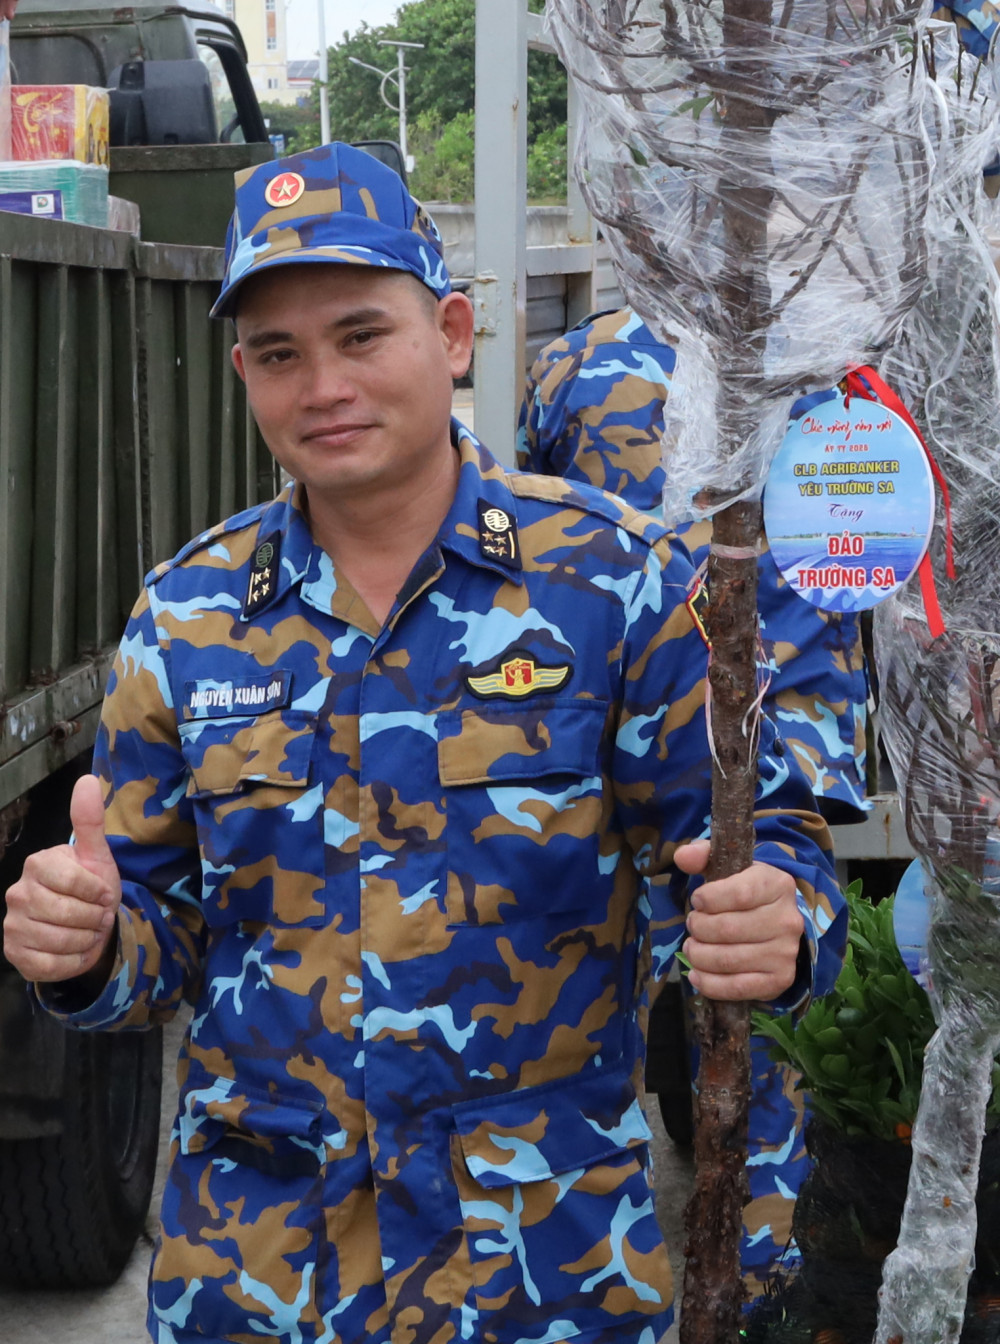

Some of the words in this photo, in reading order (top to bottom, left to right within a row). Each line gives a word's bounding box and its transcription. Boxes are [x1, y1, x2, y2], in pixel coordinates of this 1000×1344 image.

[794, 463, 817, 476] CLB
[820, 460, 900, 476] AGRIBANKER
[798, 481, 823, 496] YÊU
[826, 479, 875, 495] TRƯỜNG
[877, 481, 895, 494] SA
[828, 503, 864, 522] Tặng
[828, 531, 864, 556] ĐẢO
[797, 564, 867, 588] TRƯỜNG
[872, 567, 896, 588] SA
[234, 684, 266, 705] XUÂN
